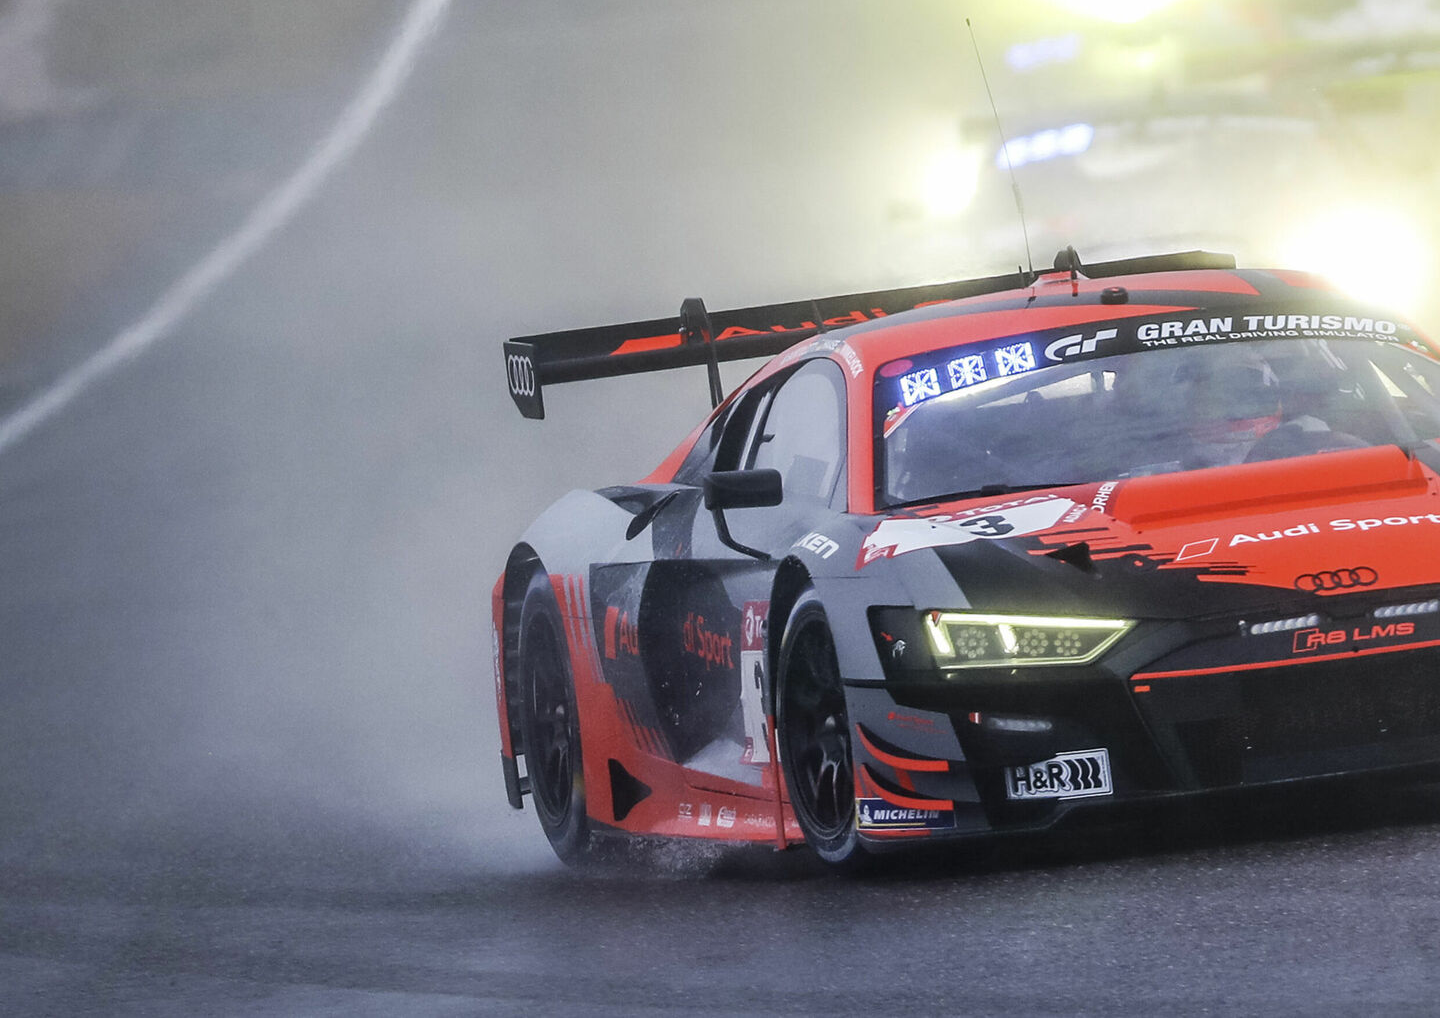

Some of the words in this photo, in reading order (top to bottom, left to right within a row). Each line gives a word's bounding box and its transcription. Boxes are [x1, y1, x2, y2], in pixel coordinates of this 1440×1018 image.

[1136, 316, 1232, 341] GRAN
[1243, 314, 1397, 335] TURISMO
[1142, 339, 1178, 347] THE
[1181, 333, 1227, 343] REAL
[1228, 328, 1299, 340] DRIVING
[1302, 329, 1400, 342] SIMULATOR
[959, 515, 1016, 537] 3
[1228, 522, 1321, 547] Audi
[696, 614, 735, 672] Sport
[1306, 630, 1347, 648] R8
[1352, 622, 1416, 641] LMS
[873, 807, 941, 821] MICHELIN
